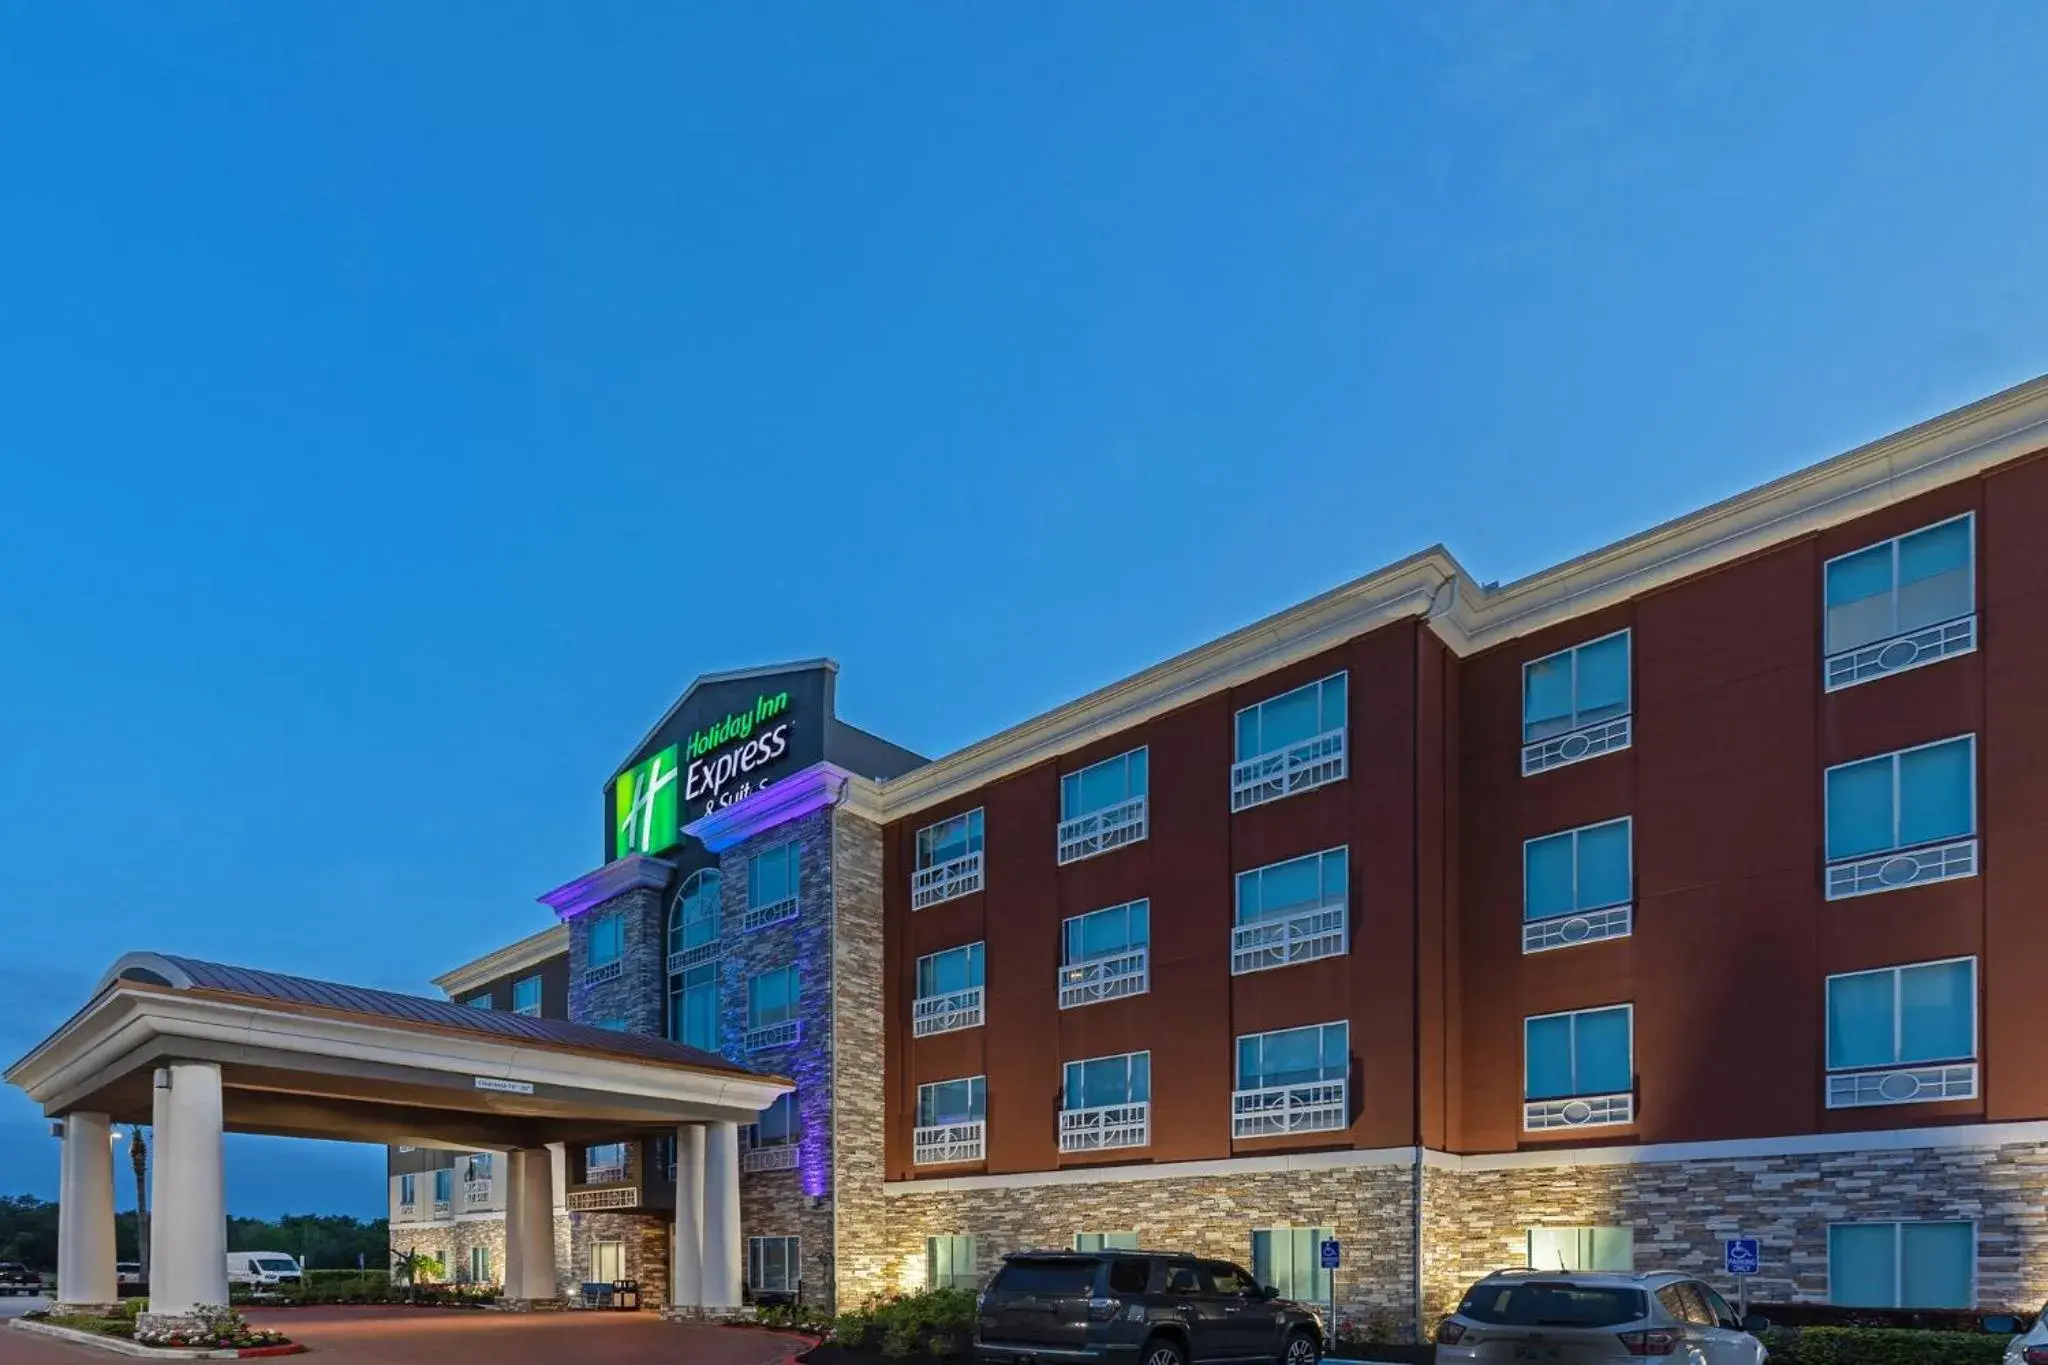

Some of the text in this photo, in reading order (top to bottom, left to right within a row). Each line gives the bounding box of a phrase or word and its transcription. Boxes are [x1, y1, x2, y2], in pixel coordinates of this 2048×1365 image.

[687, 692, 788, 761] Holiday Inn
[685, 723, 788, 801] Express
[720, 777, 769, 808] Suits
